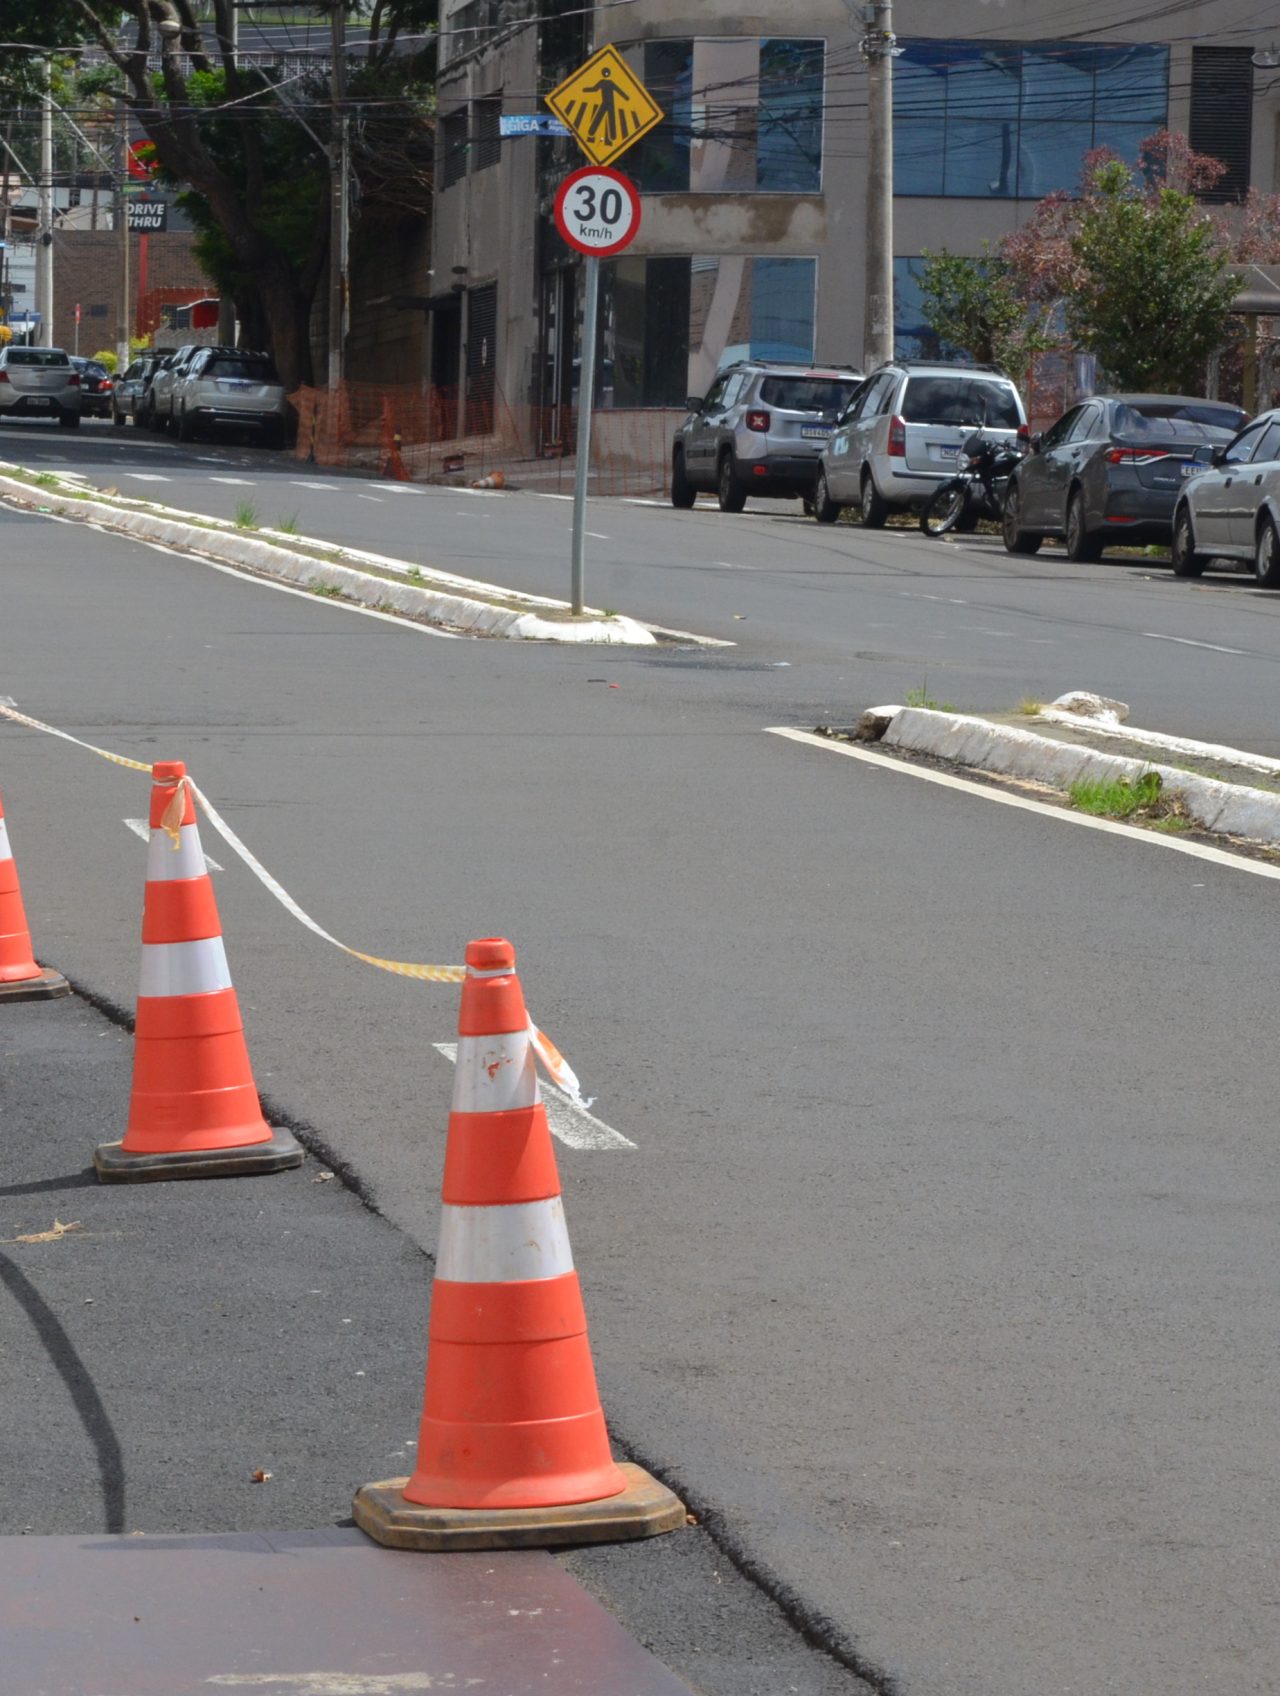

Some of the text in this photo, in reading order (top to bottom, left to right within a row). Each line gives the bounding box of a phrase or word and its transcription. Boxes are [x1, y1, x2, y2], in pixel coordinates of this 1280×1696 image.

[128, 203, 165, 215] DRIVE
[573, 185, 623, 225] 30
[128, 216, 162, 228] THRU
[579, 223, 613, 239] km/h
